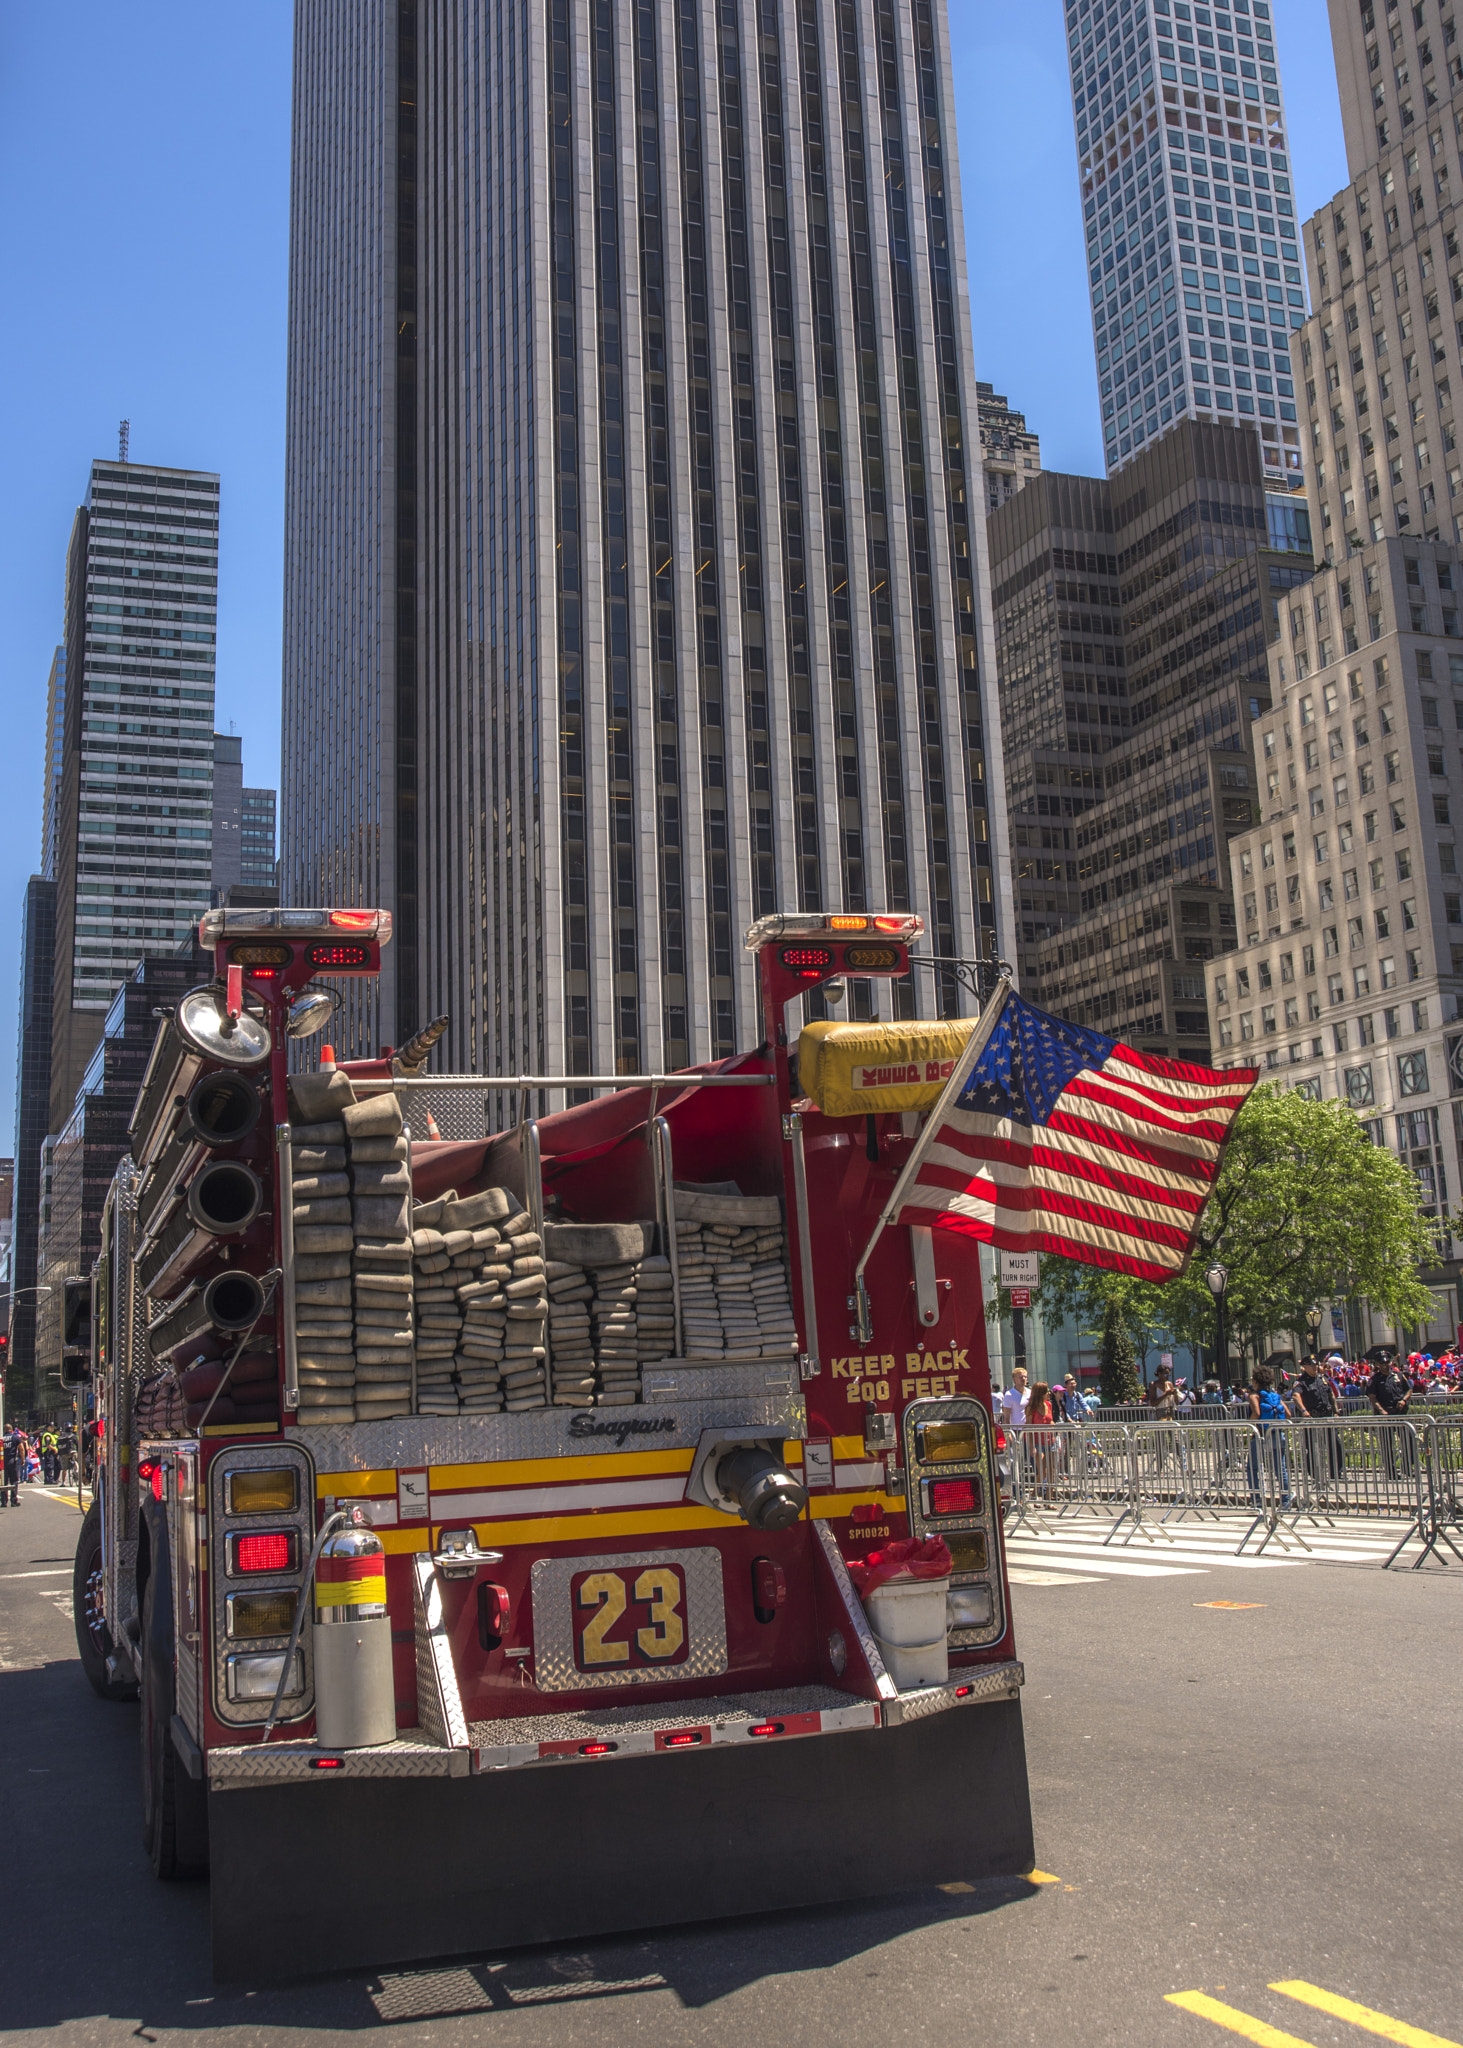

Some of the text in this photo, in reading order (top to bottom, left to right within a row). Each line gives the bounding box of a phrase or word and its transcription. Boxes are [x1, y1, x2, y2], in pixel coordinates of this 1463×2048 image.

[862, 1060, 956, 1087] KEEP BA
[1002, 1273, 1037, 1282] TURN RIGHT
[1009, 1259, 1029, 1269] MUST
[831, 1349, 970, 1378] KEEP BACK
[846, 1375, 959, 1403] 200 FEET
[568, 1413, 676, 1447] Seagrave
[848, 1526, 890, 1540] SP10020
[576, 1568, 684, 1669] 23
